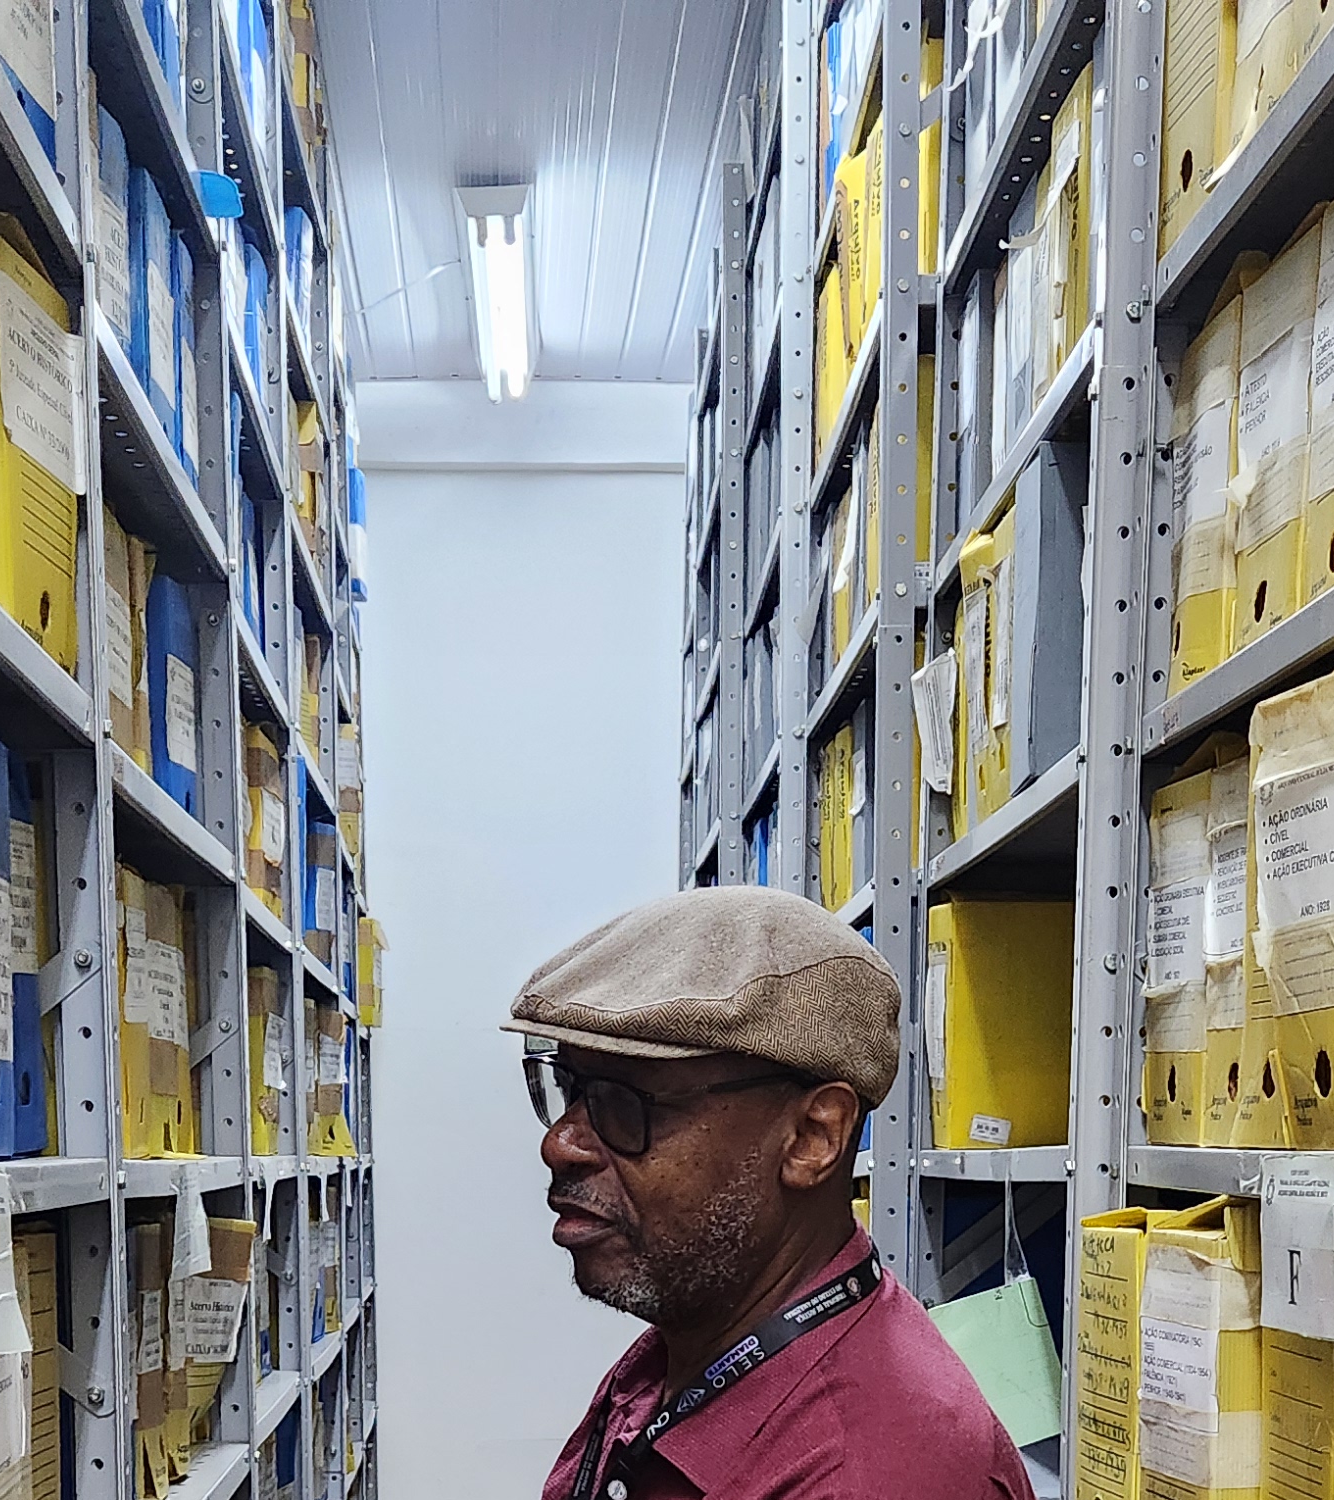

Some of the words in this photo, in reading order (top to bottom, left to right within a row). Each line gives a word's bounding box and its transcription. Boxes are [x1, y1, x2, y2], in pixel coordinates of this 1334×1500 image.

[8, 327, 36, 361] ACERVO
[1268, 811, 1289, 828] AÇÃO
[1290, 798, 1329, 822] ORDINÁRIA
[1269, 829, 1290, 845] CÍVEL
[1271, 841, 1309, 863] COMERCIAL
[1272, 861, 1291, 880] AÇÃO
[1291, 853, 1329, 875] EXECUTIVA
[1300, 904, 1315, 917] ANO:
[1287, 1250, 1301, 1305] F
[713, 1347, 765, 1388] SELO
